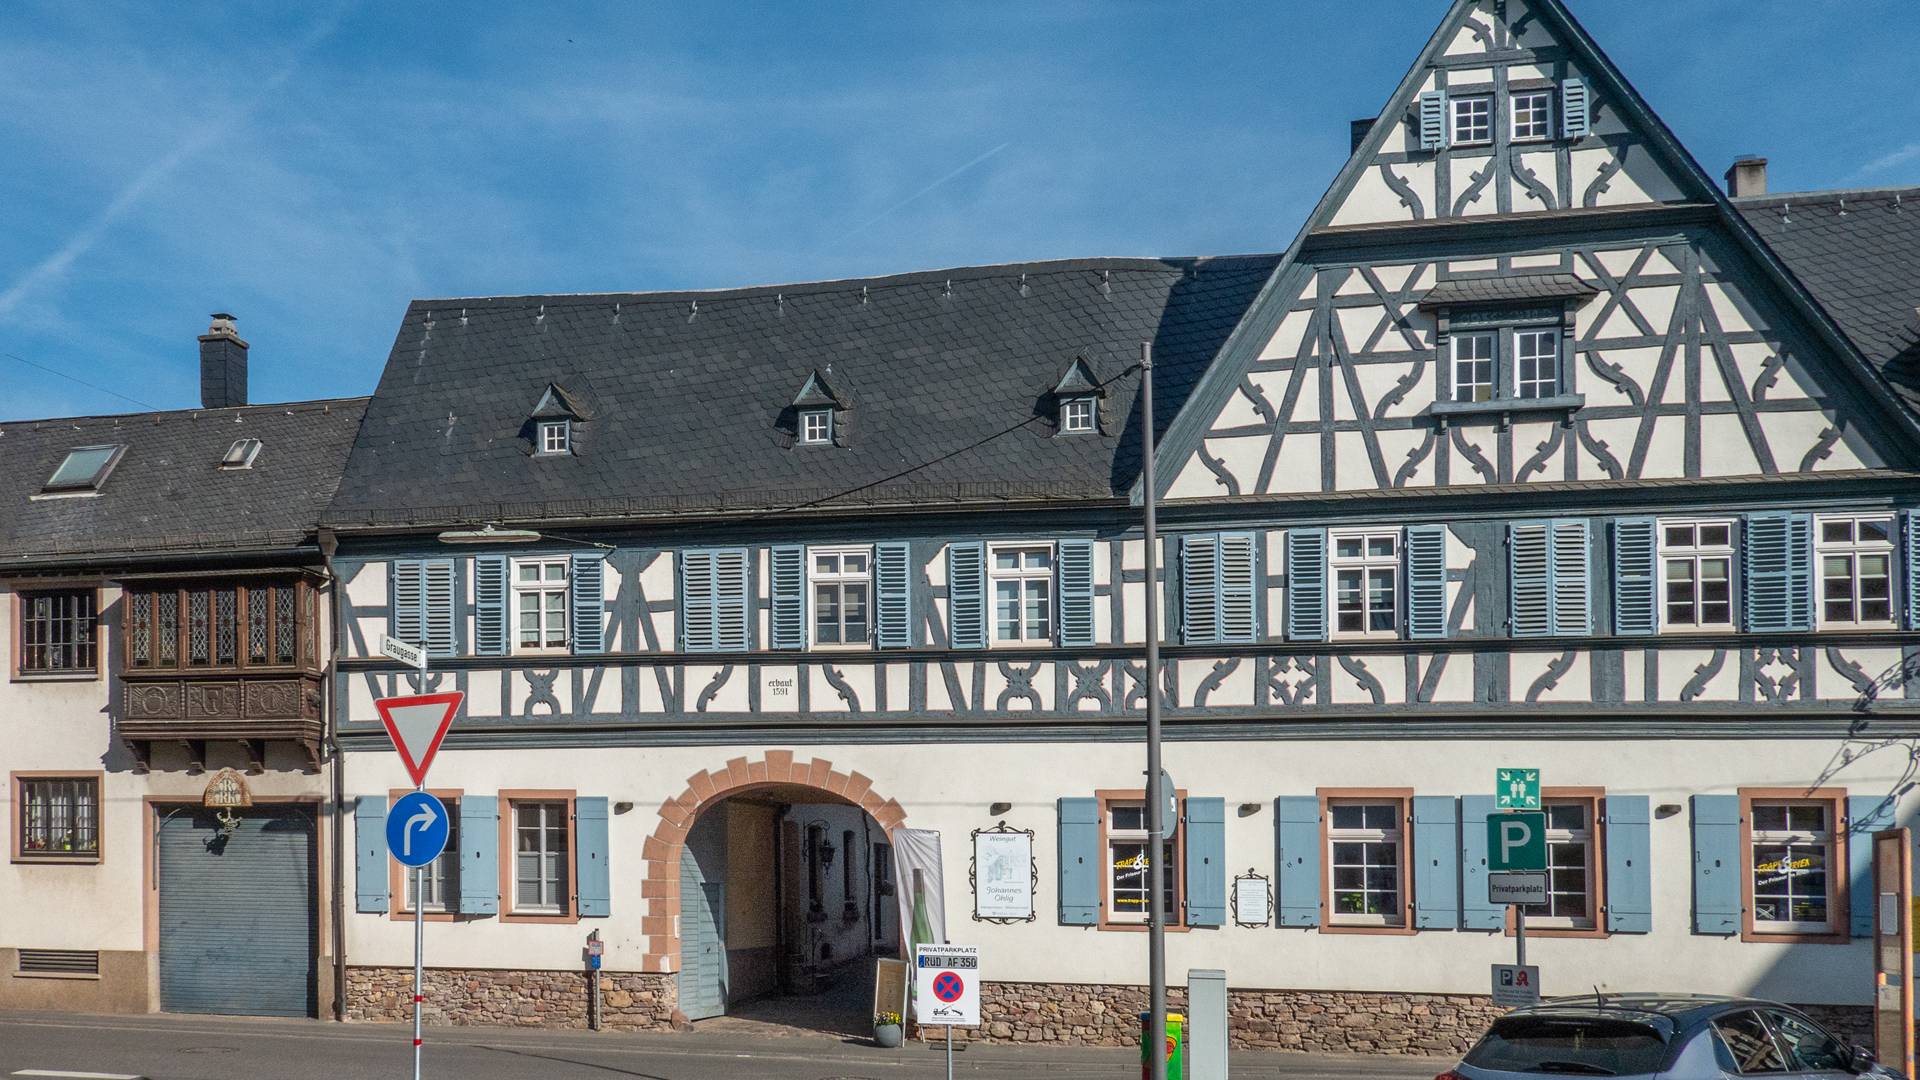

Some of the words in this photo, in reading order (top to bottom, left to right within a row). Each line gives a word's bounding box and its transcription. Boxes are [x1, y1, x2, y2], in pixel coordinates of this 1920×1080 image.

[386, 639, 417, 661] Graugasse
[768, 678, 793, 687] erbaut
[1501, 821, 1531, 863] P
[1492, 885, 1543, 894] Privatparkplatz
[995, 894, 1014, 902] Ohlig
[947, 958, 958, 968] AF
[960, 958, 977, 968] 350
